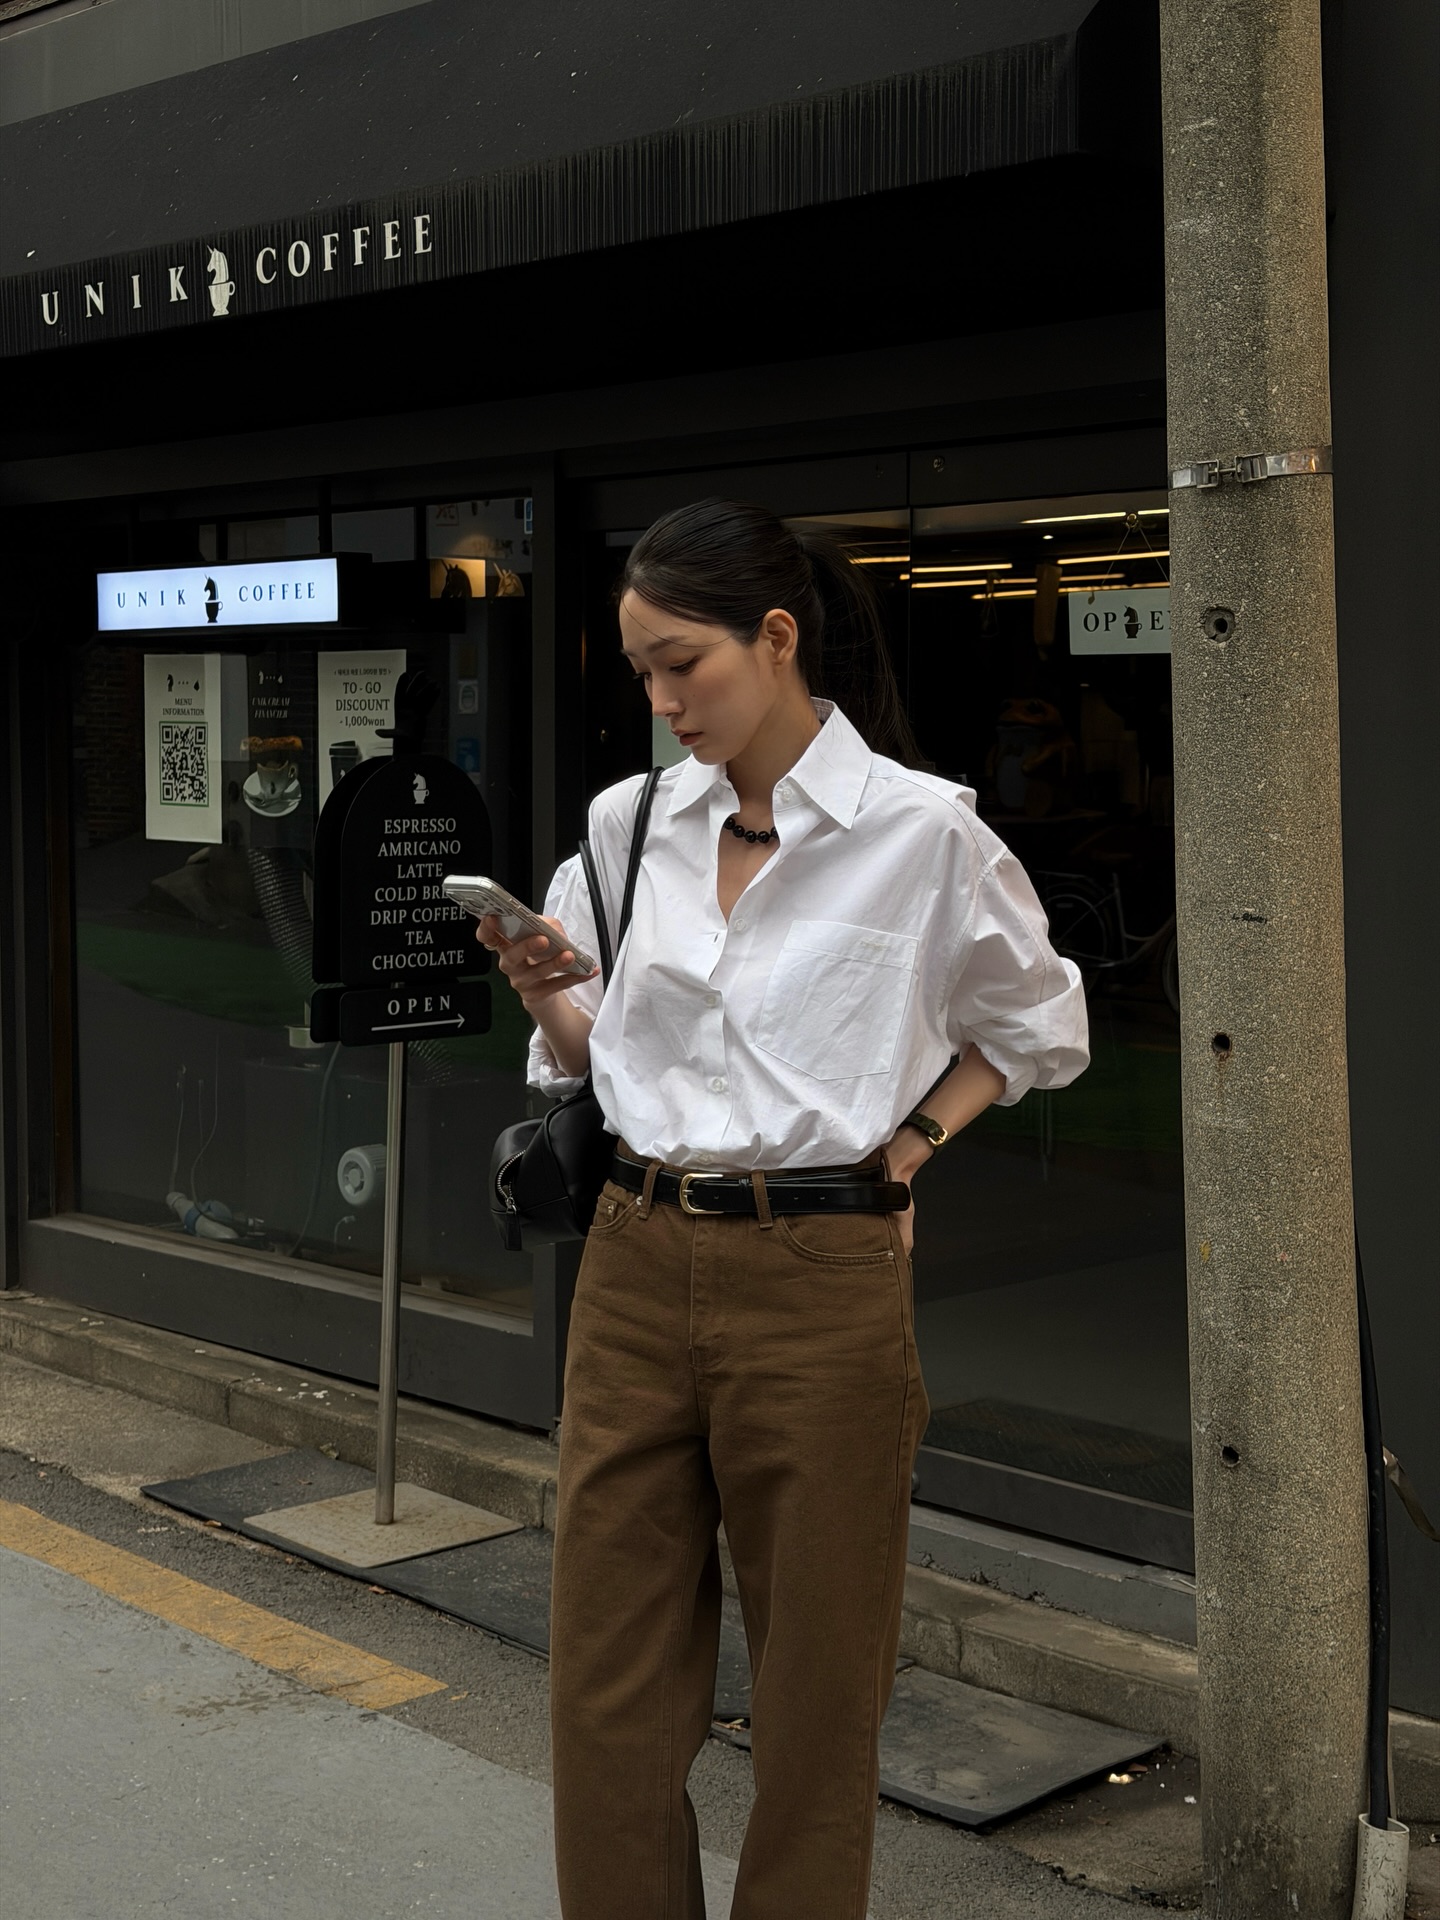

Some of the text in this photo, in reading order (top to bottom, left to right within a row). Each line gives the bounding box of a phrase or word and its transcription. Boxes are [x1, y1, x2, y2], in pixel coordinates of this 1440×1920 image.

[41, 214, 432, 325] UNIK COFFEE
[117, 581, 316, 609] UNIK COFFEE
[1083, 610, 1171, 632] OPE
[174, 698, 193, 706] MENU
[336, 699, 390, 711] DISCOUNT
[162, 708, 205, 716] INFORMATION
[384, 818, 457, 835] ESPRESSO
[377, 840, 461, 858] AMRICANO
[397, 862, 443, 879] LATTE
[374, 886, 417, 902] COLD
[370, 905, 467, 926] DRIP COFFEE
[405, 929, 434, 946] TEA
[372, 949, 464, 970] CHOCOLATE
[387, 994, 451, 1016] OPEN
